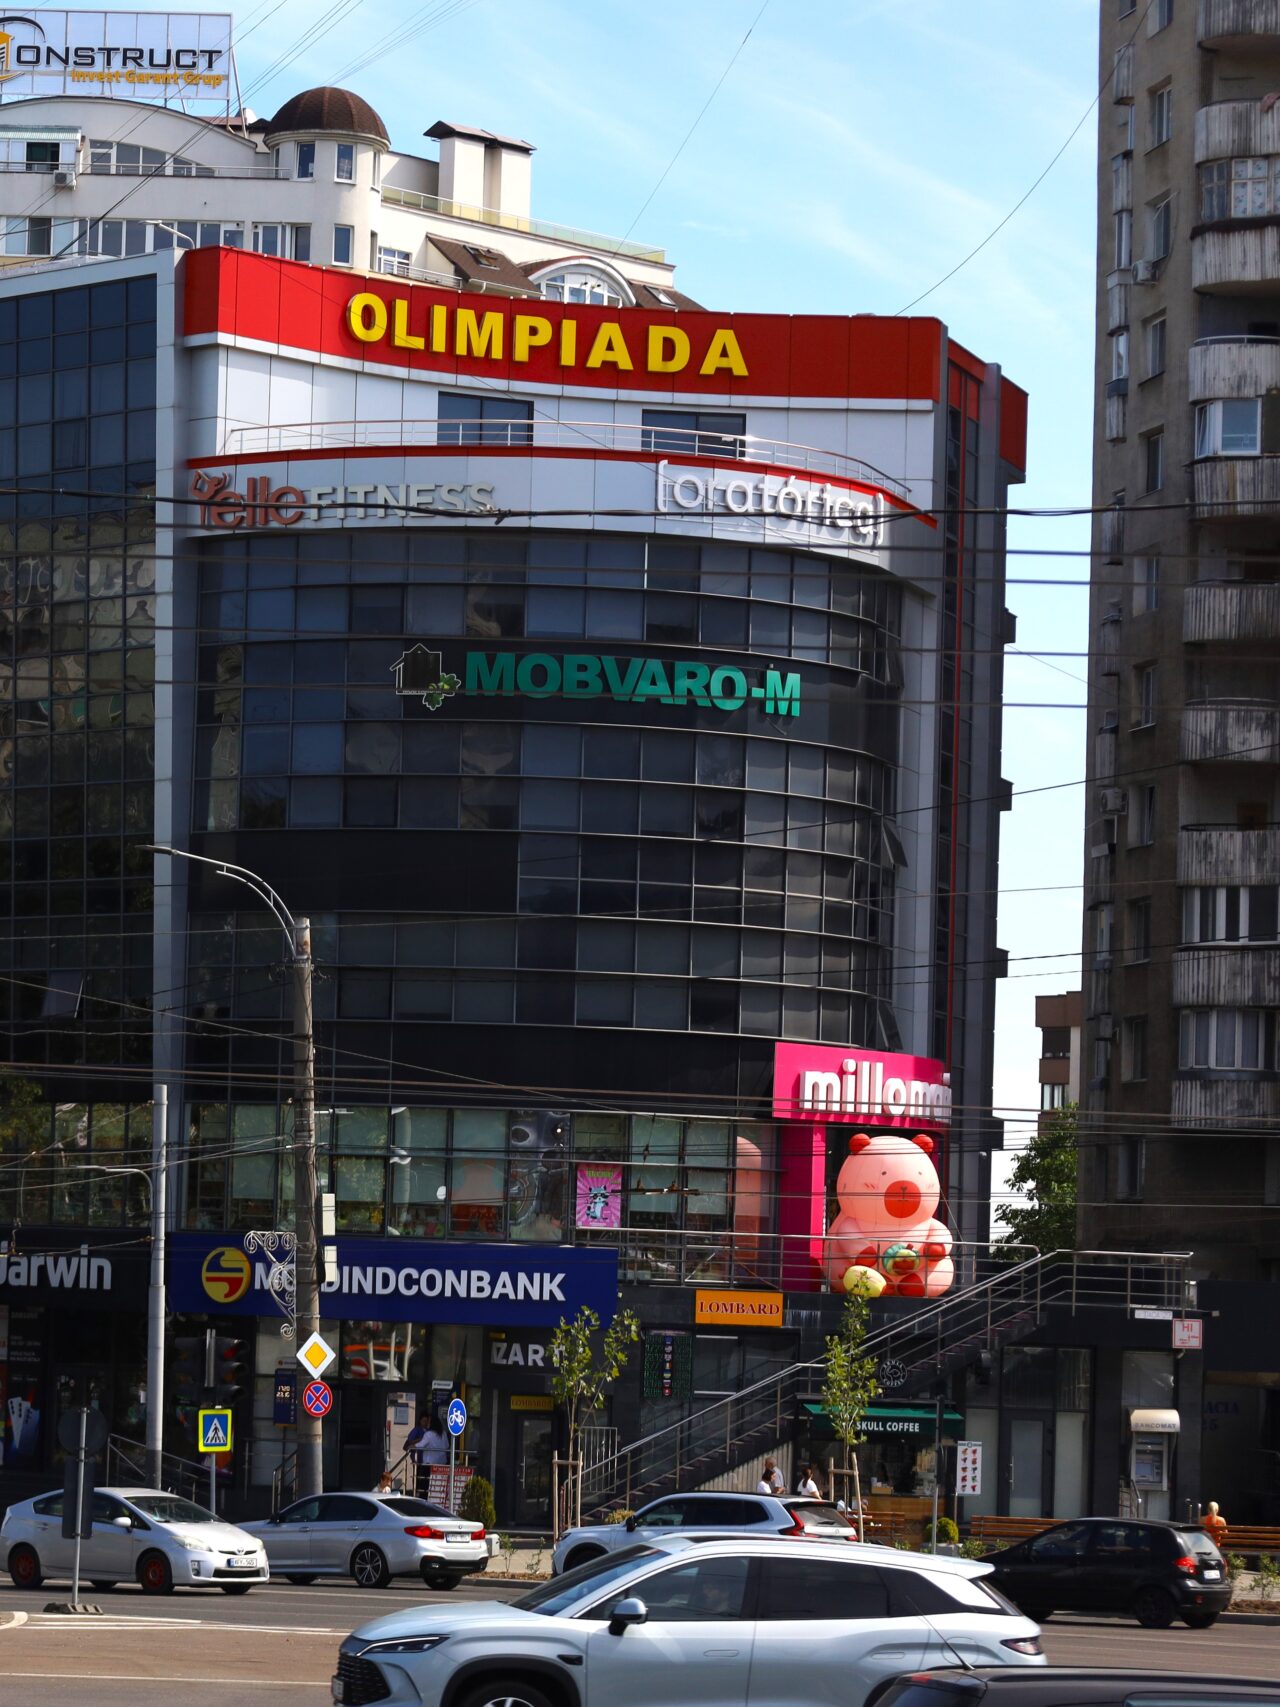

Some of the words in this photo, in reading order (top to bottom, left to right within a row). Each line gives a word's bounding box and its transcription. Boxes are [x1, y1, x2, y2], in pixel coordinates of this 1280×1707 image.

[125, 69, 179, 85] Garant
[183, 71, 224, 89] Grup
[346, 292, 750, 377] OLIMPIADA
[309, 481, 486, 521] FITNESS
[465, 650, 802, 717] MOBVARO-M
[700, 1301, 780, 1315] LOMBARD
[856, 1421, 884, 1432] SKULL
[886, 1421, 920, 1432] COFFEE
